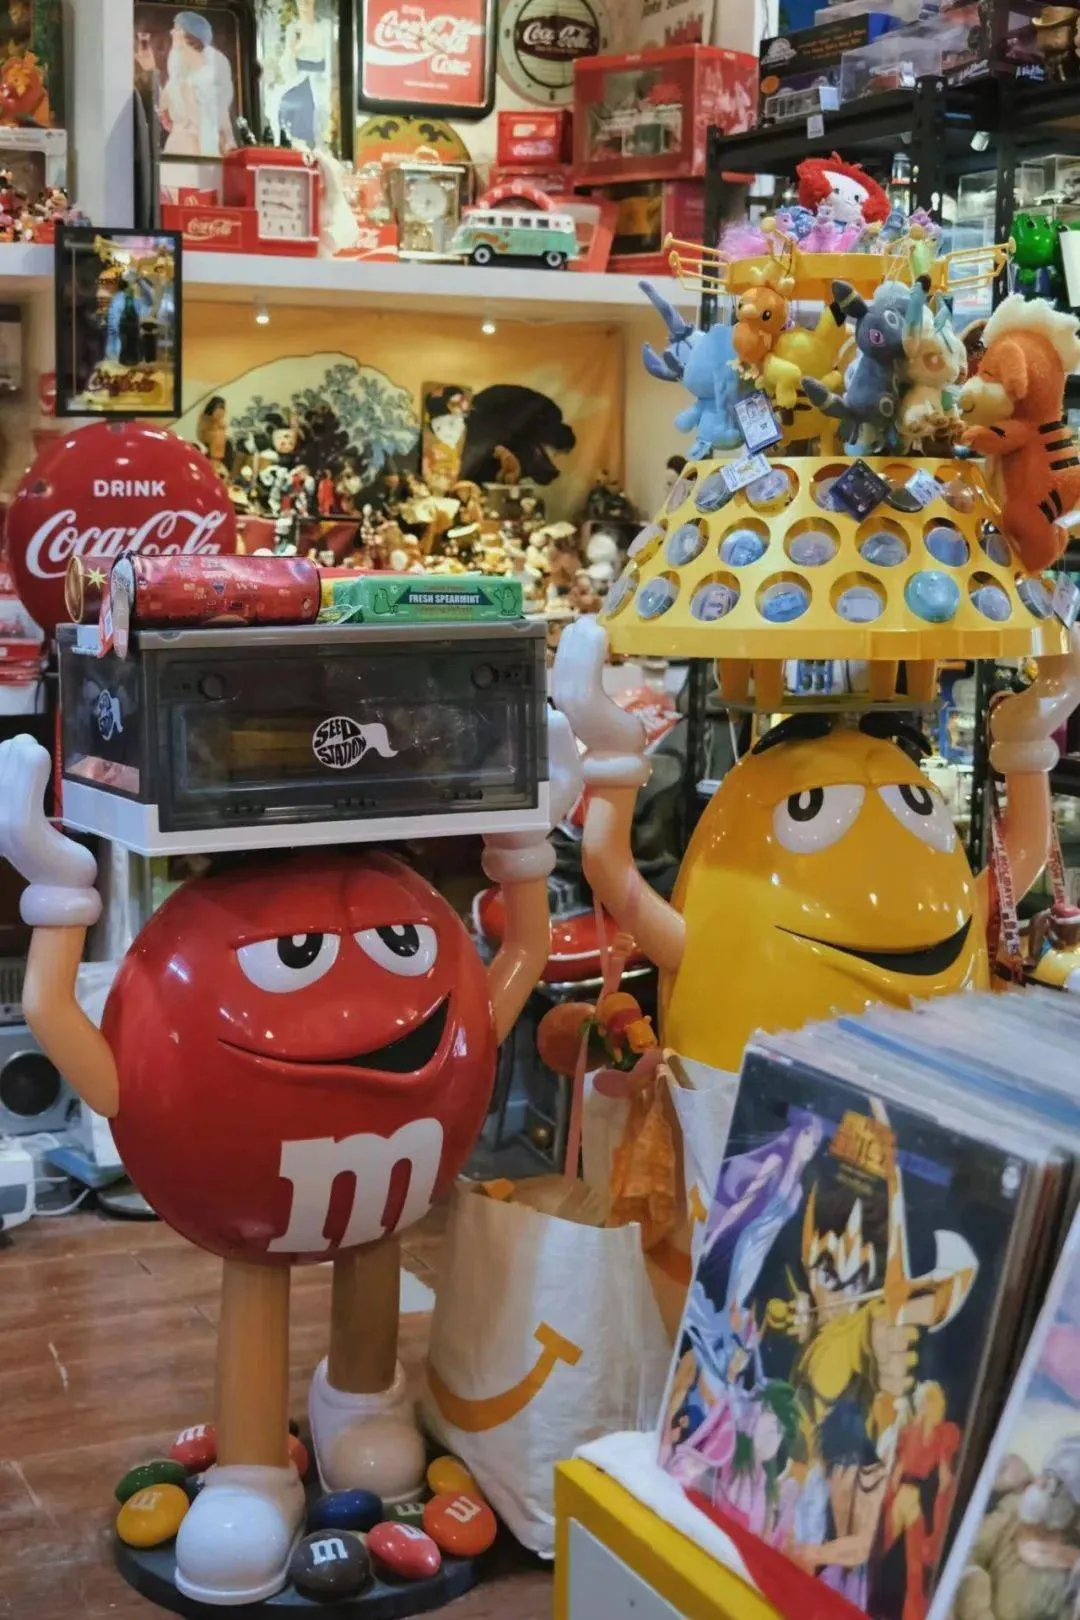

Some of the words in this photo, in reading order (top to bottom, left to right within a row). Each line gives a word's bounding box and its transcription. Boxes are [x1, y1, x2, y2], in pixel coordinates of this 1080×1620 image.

[93, 479, 166, 497] DRINK
[409, 594, 434, 603] FRESH
[434, 594, 480, 604] SPEARMINT
[314, 719, 361, 748] SEED
[317, 736, 366, 766] STATION
[266, 1117, 444, 1253] m
